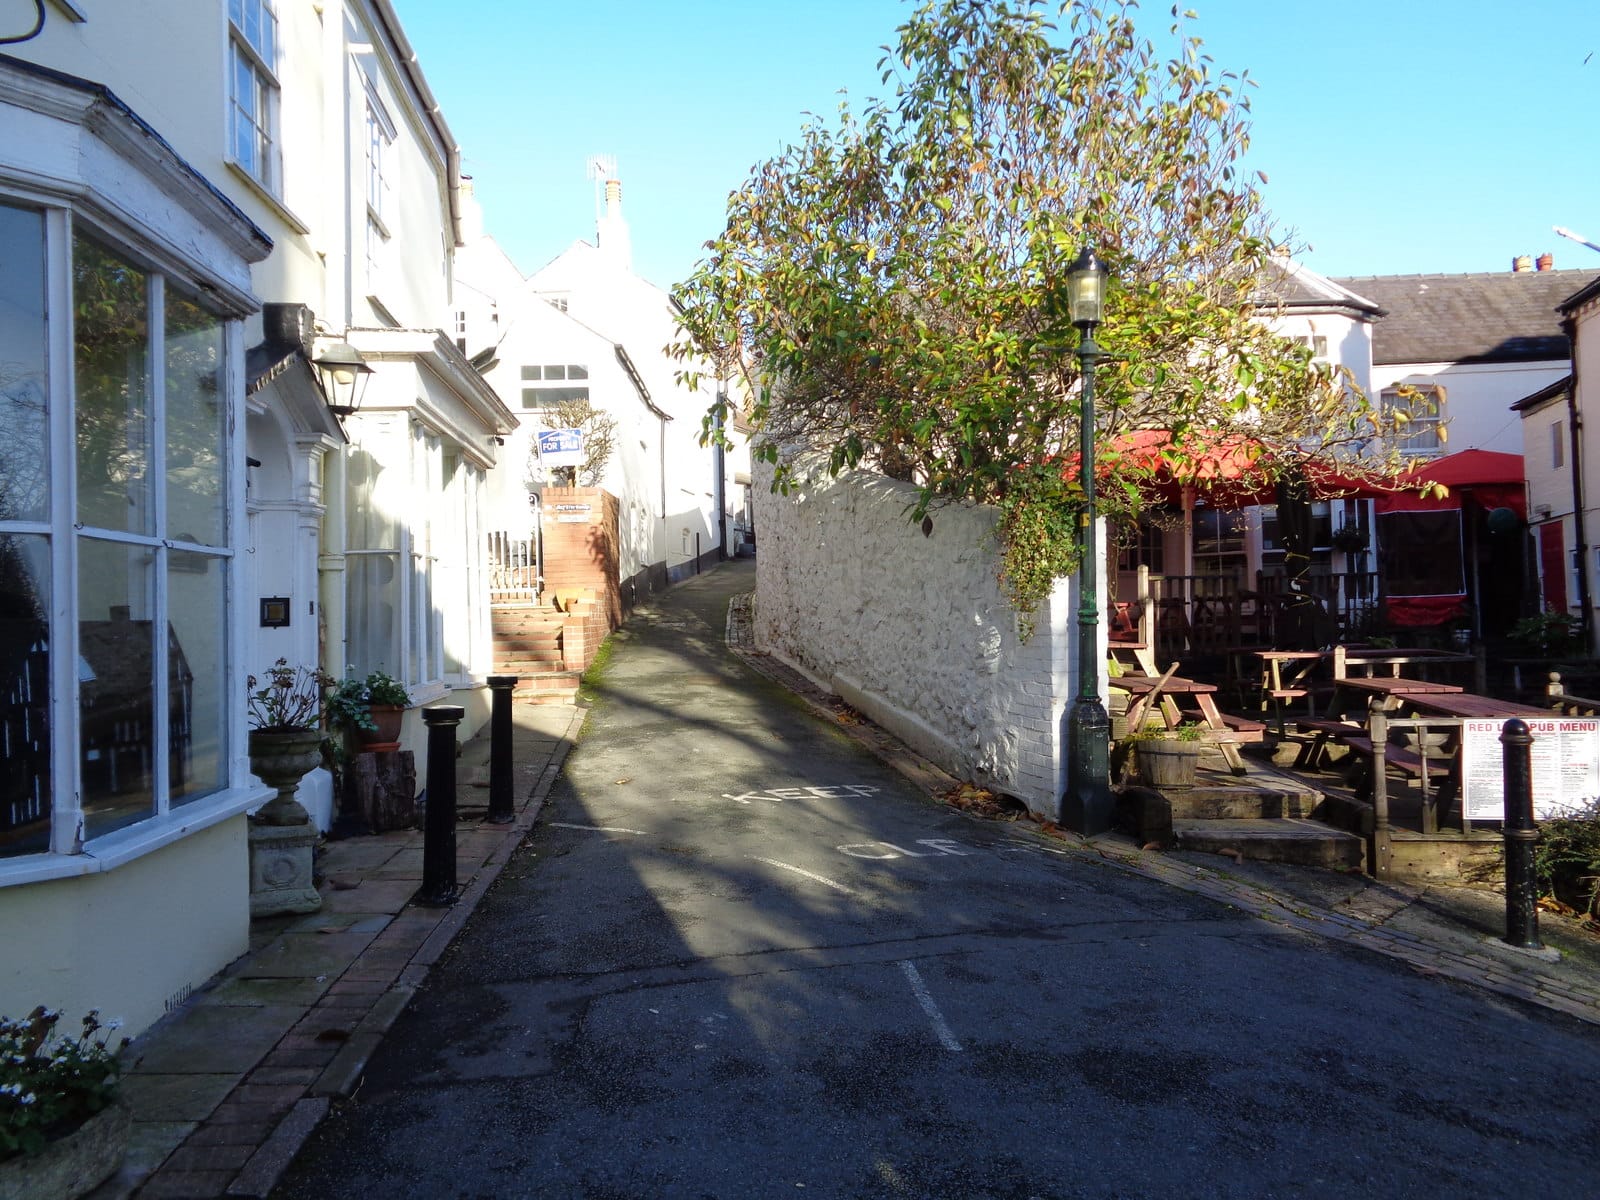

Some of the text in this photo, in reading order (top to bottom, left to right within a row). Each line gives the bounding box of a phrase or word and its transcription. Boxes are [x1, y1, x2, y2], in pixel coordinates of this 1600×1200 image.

[542, 442, 558, 451] FOR
[1469, 723, 1493, 732] RED
[1530, 723, 1555, 732] PUB
[1559, 722, 1596, 732] MENU
[721, 785, 881, 804] KEEP
